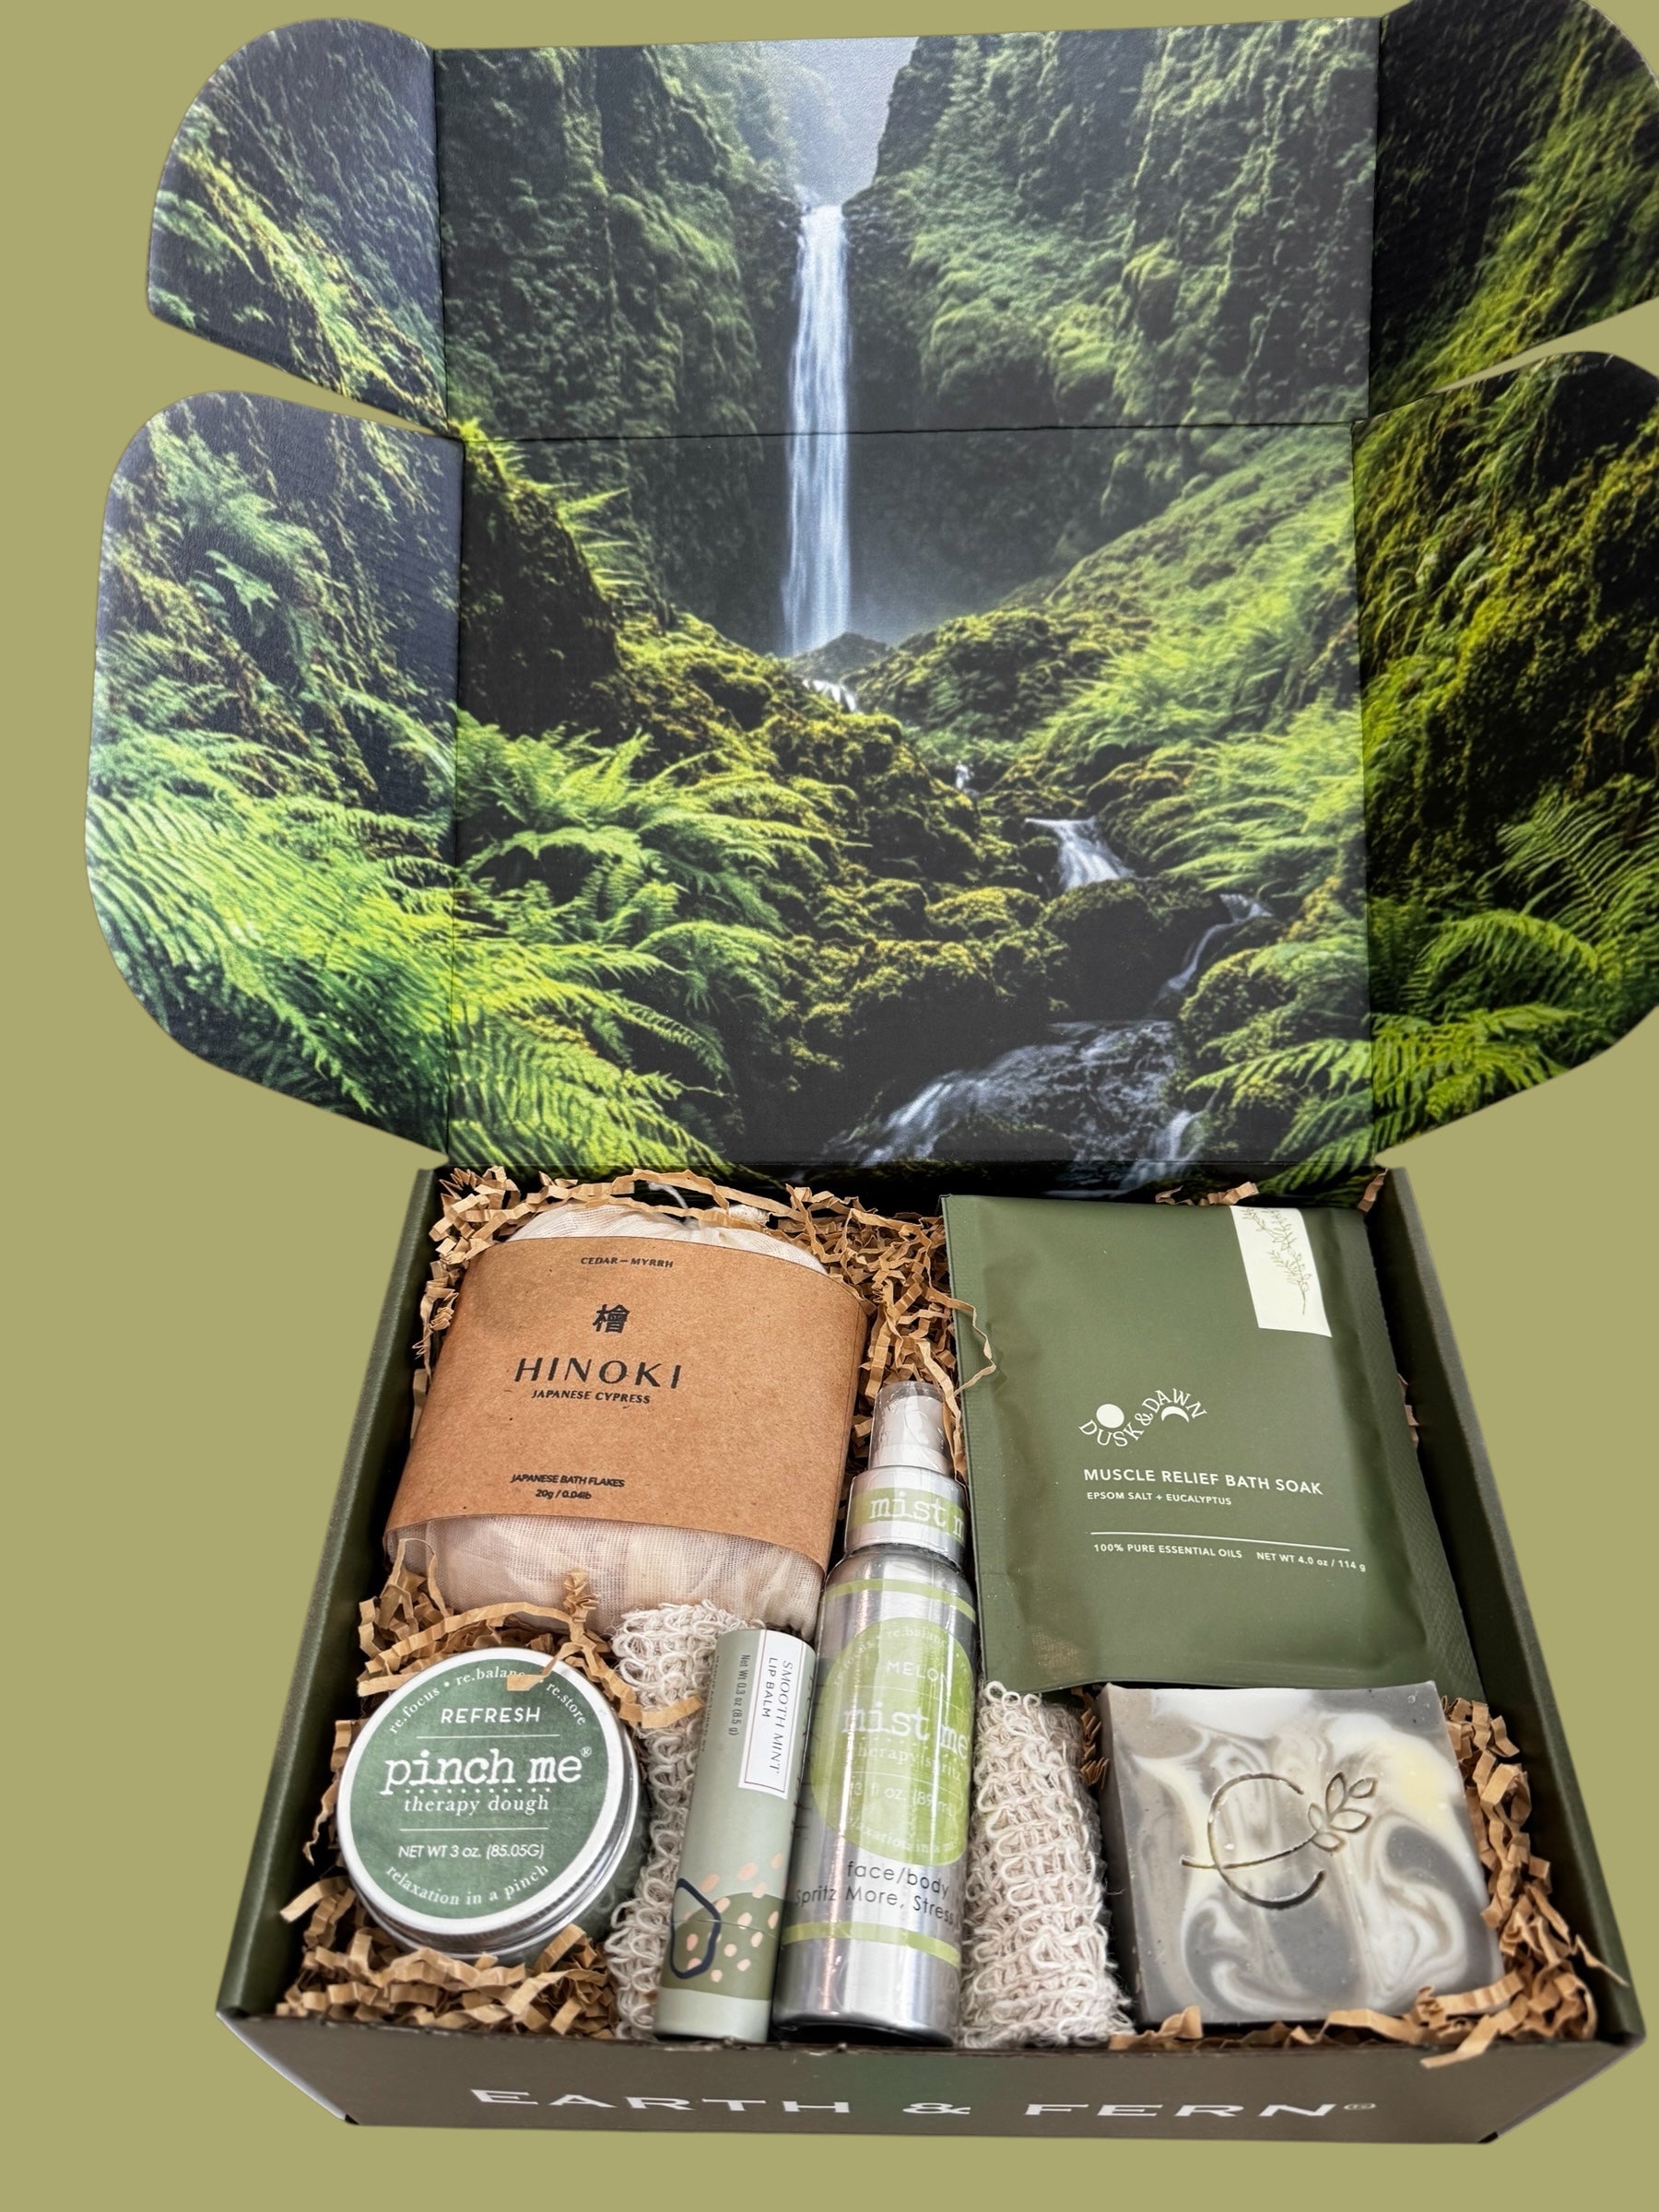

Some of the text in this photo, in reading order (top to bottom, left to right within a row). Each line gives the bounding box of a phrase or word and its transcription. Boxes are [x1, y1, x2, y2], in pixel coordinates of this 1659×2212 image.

[581, 1256, 618, 1265] CEDAR
[630, 1257, 674, 1268] MYRRH
[514, 1357, 682, 1389] HINOKI
[531, 1390, 651, 1405] JAPANESE CYPRESS
[1077, 1387, 1208, 1447] DUSK & DAWN
[510, 1474, 626, 1488] JAPANESE BATH FLAKES
[535, 1488, 554, 1500] 20g
[1083, 1468, 1324, 1495] MUSCLE RELIEF BATH SOAK
[869, 1490, 947, 1528] mist
[1087, 1491, 1125, 1500] EPSOM
[1128, 1492, 1153, 1500] SALT
[1166, 1493, 1232, 1506] EUCALYPTUS
[1093, 1543, 1124, 1553] 100%
[1127, 1544, 1157, 1554] PURE
[1159, 1545, 1217, 1557] ESSENTIAL
[1218, 1548, 1242, 1559] OILS
[1256, 1551, 1277, 1561] NET
[1278, 1553, 1296, 1564] WT
[1298, 1556, 1314, 1566] 4.0
[1316, 1559, 1329, 1567] oz
[1337, 1559, 1358, 1570] 114
[1359, 1564, 1367, 1573] g
[739, 1654, 750, 1667] Net
[886, 1660, 949, 1688] MELON
[738, 1669, 749, 1681] Wt
[761, 1657, 779, 1718] LIP BALM
[389, 1687, 441, 1735] re.focus
[546, 1682, 587, 1726] re.store
[441, 1706, 542, 1724] REFRESH
[734, 1697, 743, 1708] oz
[769, 1660, 794, 1774] SMOOTH MINT
[841, 1700, 931, 1742] mist
[380, 1748, 515, 1796] pinch
[404, 1794, 550, 1817] therapy dough
[398, 1843, 545, 1860] NET WT 3 oz. (85.05G)
[385, 1864, 549, 1906] relaxation in a pinch
[846, 1860, 950, 1900] face/body
[795, 1886, 837, 1908] Spritz
[845, 1886, 905, 1909] More,
[912, 1895, 956, 1925] Stress
[470, 2088, 850, 2113] EARTH
[902, 2101, 971, 2115] &
